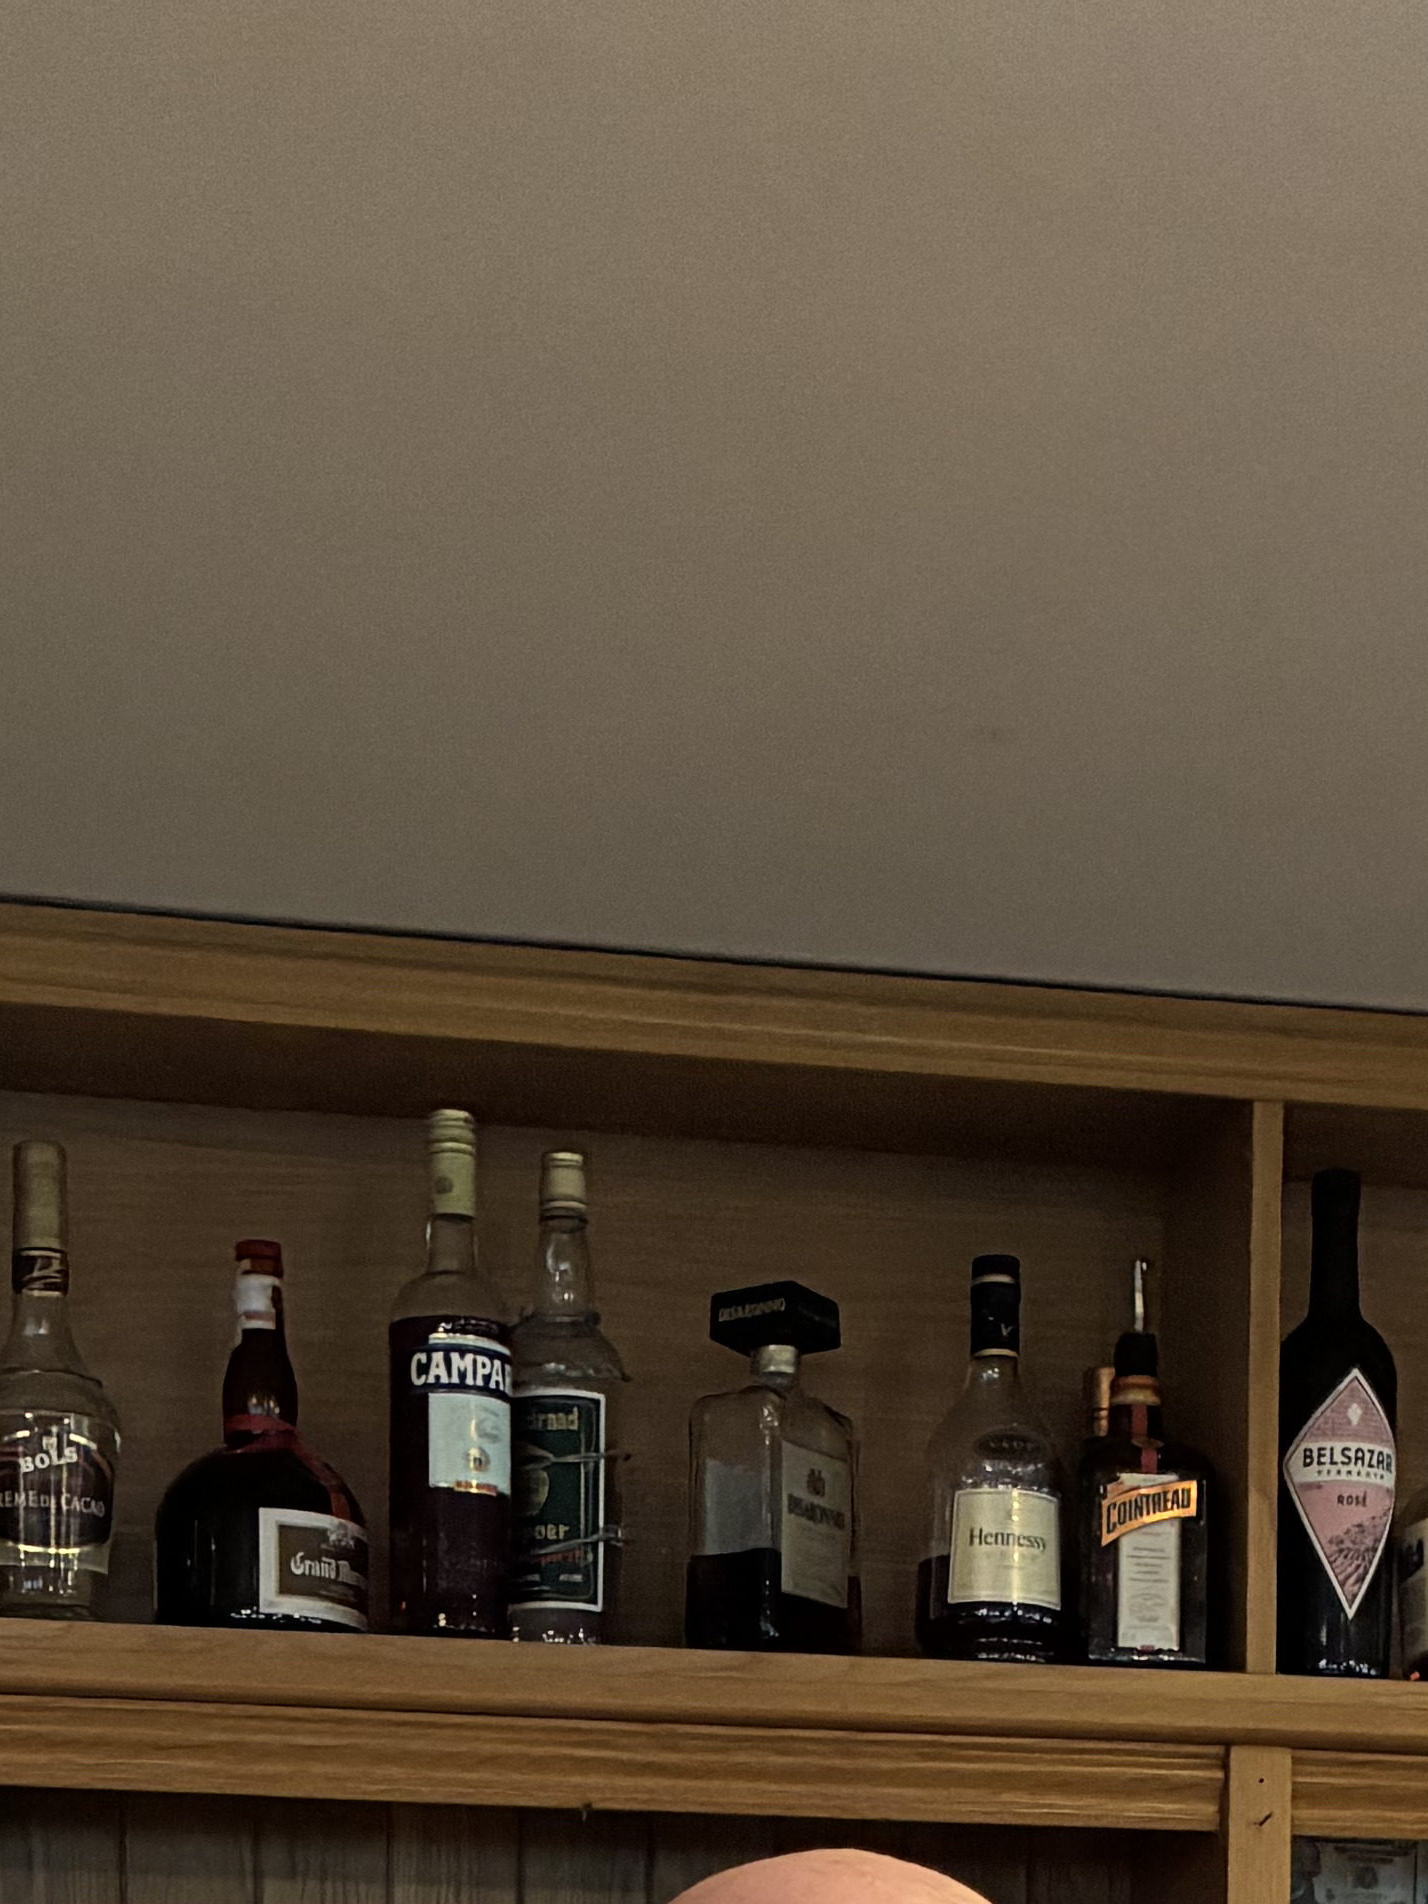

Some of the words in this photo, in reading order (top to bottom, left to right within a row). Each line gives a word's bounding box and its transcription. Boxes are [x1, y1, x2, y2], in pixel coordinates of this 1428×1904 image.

[19, 1445, 79, 1473] BOLS
[1303, 1445, 1393, 1475] BELSAZAR
[1106, 1487, 1192, 1535] COINTREAU
[968, 1527, 1047, 1552] Hennessy
